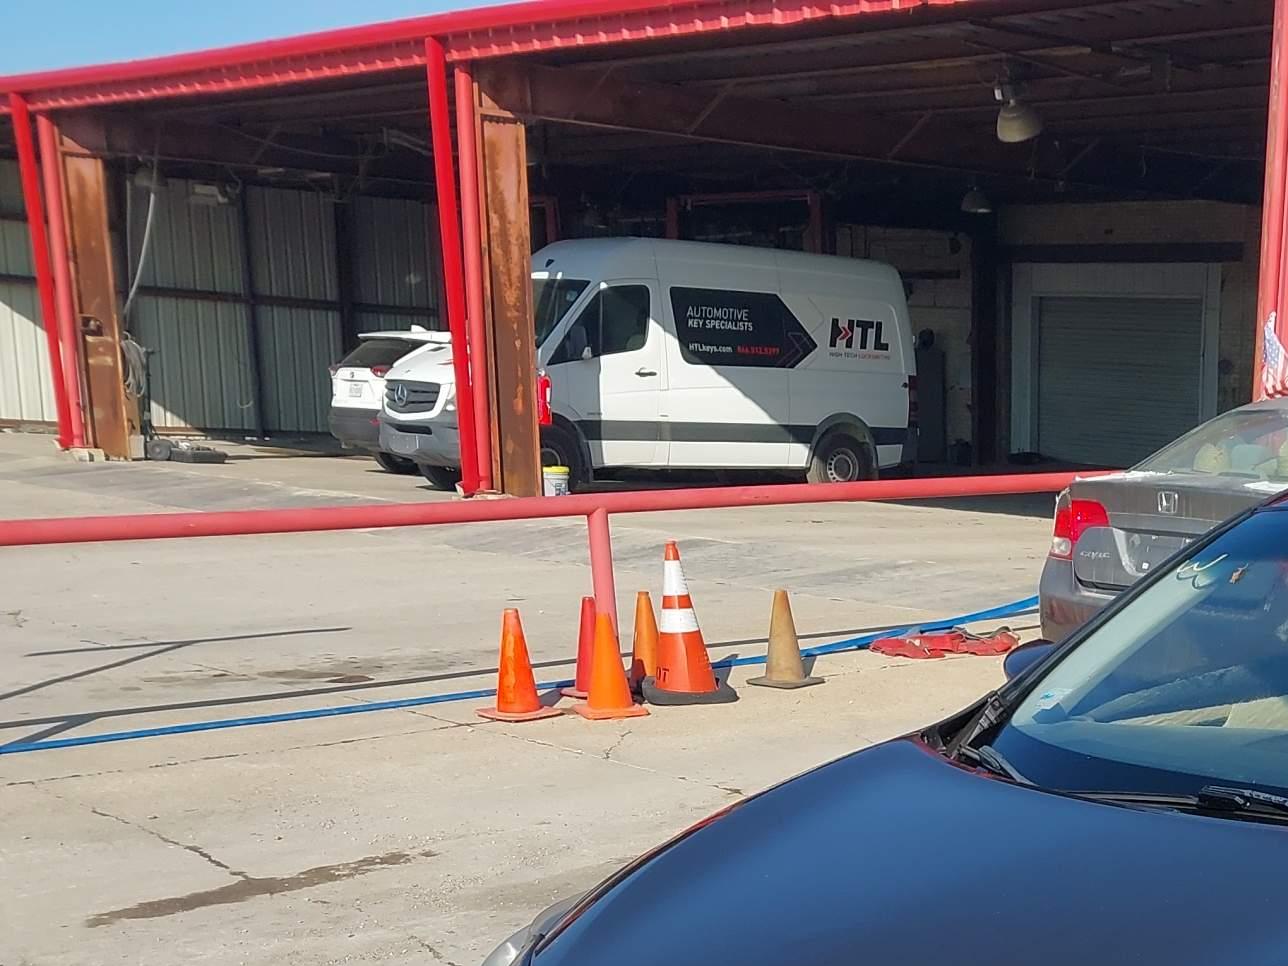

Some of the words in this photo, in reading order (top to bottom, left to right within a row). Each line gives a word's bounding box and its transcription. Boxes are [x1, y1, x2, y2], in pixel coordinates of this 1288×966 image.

[686, 306, 749, 320] AUTOMOTIVE
[688, 319, 703, 328] KEY
[705, 320, 753, 331] SPECIALISTS
[829, 318, 889, 351] HTL
[688, 343, 733, 354] HTLkeys.com
[1079, 551, 1111, 560] CIVIC
